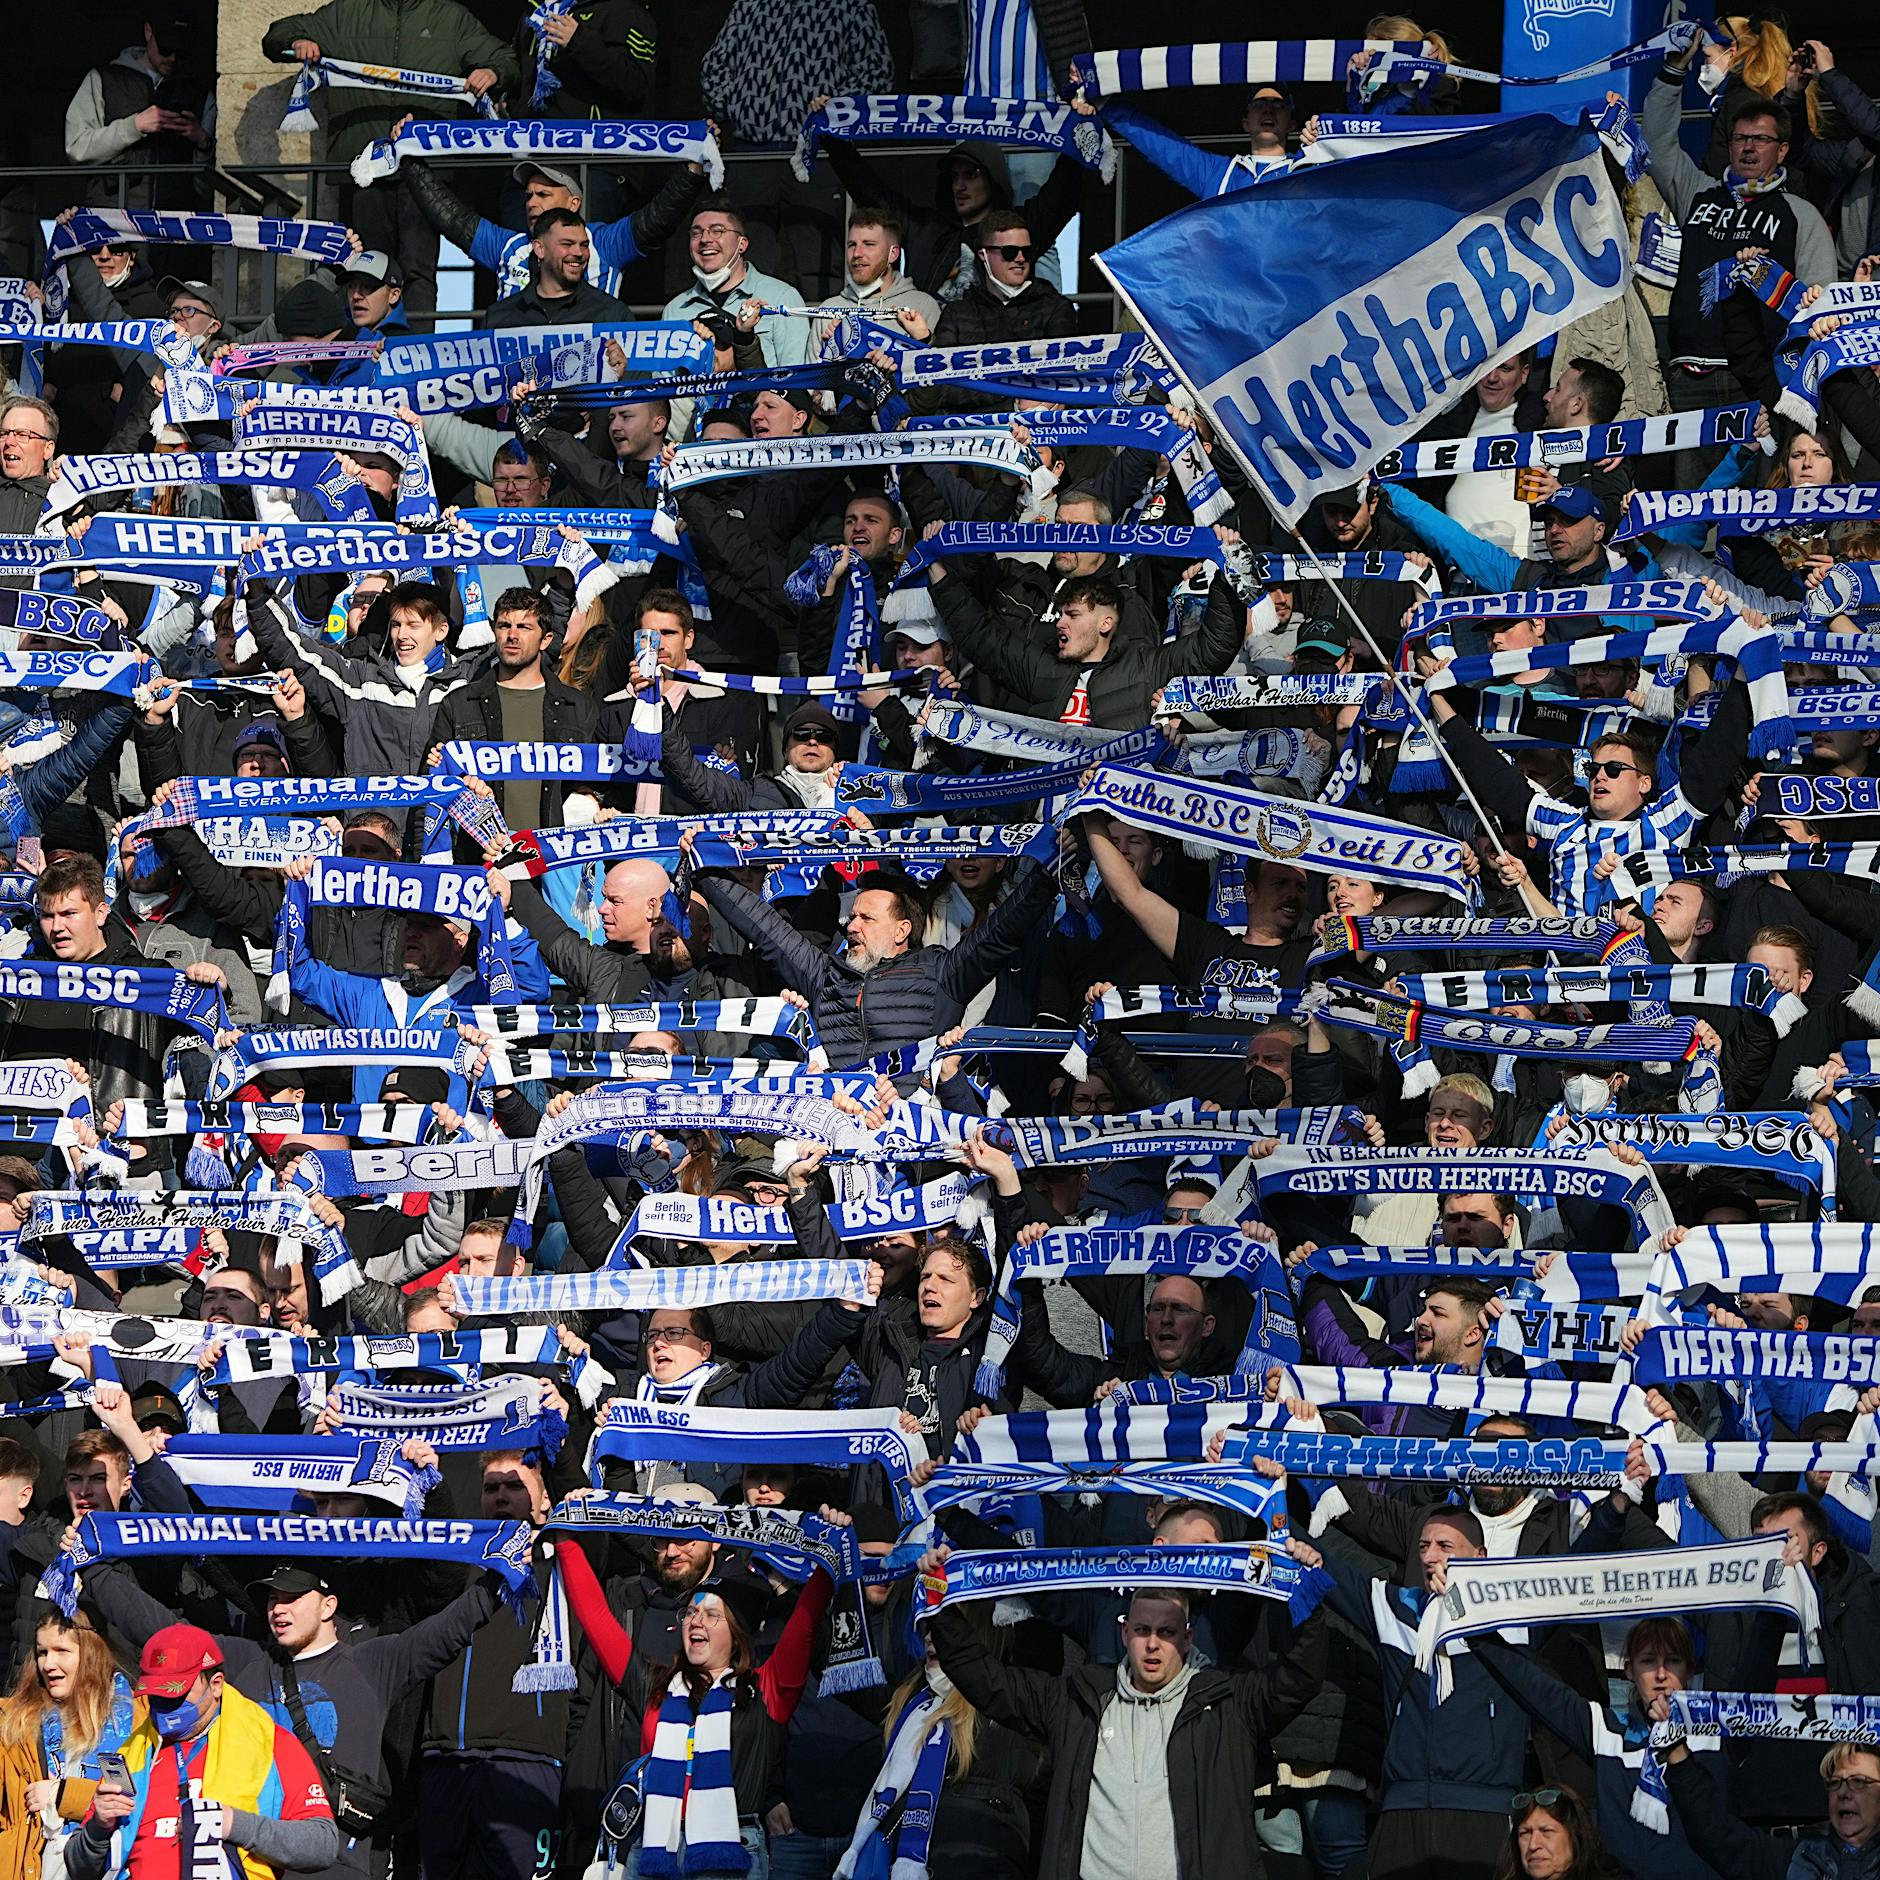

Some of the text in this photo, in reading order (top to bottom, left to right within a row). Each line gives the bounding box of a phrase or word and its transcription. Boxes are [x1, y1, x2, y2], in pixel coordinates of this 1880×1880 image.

[1625, 52, 1651, 65] Club
[400, 71, 453, 87] BERLIN
[825, 94, 1072, 135] BERLIN
[1342, 119, 1382, 134] 1892
[415, 120, 690, 152] Hertha BSC
[854, 121, 1065, 148] ARE THE CHAMPIONS
[1688, 202, 1782, 241] BERLIN
[1707, 227, 1752, 241] SEIT 1892
[1829, 287, 1854, 306] IN
[380, 328, 706, 376] ICH BIN WEISS
[1213, 173, 1622, 508] Hertha BSC
[914, 338, 1105, 375] BERLIN
[416, 367, 503, 412] BSC
[245, 410, 362, 437] HERTHA
[1137, 411, 1171, 437] 92
[244, 437, 368, 450] Olympiastadion
[62, 450, 300, 493] Hertha BSC
[673, 437, 1027, 480] ERTHANER AUS BERLIN
[1638, 484, 1874, 526] Hertha BSC
[939, 521, 1196, 547] HERTHA BSC
[264, 531, 516, 572] Hertha BSC
[1607, 580, 1711, 616] BSC
[17, 592, 111, 643] BSC
[29, 650, 114, 677] BSC
[1810, 650, 1870, 664] BERLIN
[1264, 687, 1319, 707] Hertha
[1796, 695, 1864, 714] BSC
[449, 741, 583, 776] Hertha
[197, 777, 358, 801] Hertha
[239, 792, 421, 808] EVERY DAY FAIR PLAY
[1085, 767, 1250, 835] Hertha BSC
[1778, 775, 1880, 816] BSC
[731, 811, 770, 820] DAMALS
[771, 810, 796, 819] MICH
[797, 810, 812, 818] DU
[814, 810, 840, 819] DASS
[546, 825, 661, 859] PAPA
[782, 844, 978, 856] DER VEREIN DEM ICH DIE TREUE SCHWÖRE
[1317, 835, 1387, 862] seit
[244, 850, 283, 862] EINEN
[309, 865, 423, 910] Hertha
[57, 964, 142, 1004] BSC
[166, 971, 188, 1017] SAISON
[252, 1028, 442, 1054] OLYMPIASTADION
[1566, 1112, 1692, 1154] Hertha
[1111, 1139, 1238, 1155] HAUPTSTADT
[1330, 1146, 1422, 1161] BERLIN
[1511, 1147, 1589, 1162] SPREE
[1288, 1167, 1607, 1198] GIBT'S NUR HERTHA BSC
[61, 1216, 92, 1231] nur
[170, 1207, 232, 1230] Hertha
[233, 1216, 267, 1232] nur
[644, 1211, 693, 1223] seit 1892
[655, 1201, 686, 1213] Berlin
[706, 1188, 919, 1235] Hert BSC
[72, 1227, 188, 1253] PAPA
[1015, 1228, 1268, 1273] HERTHA BSC
[99, 1252, 166, 1263] MITGENOMMEN
[1660, 1329, 1814, 1379] HERTHA
[606, 1404, 691, 1427] ERTHA BSC
[1242, 1429, 1604, 1479] HERTHA BSC
[253, 1461, 343, 1482] HERTHA BSC
[1463, 1463, 1622, 1489] Traditionsverein
[116, 1517, 474, 1546] EINMAL HERTHANER
[714, 1526, 772, 1545] BERLIN
[840, 1530, 853, 1577] VEREIN
[959, 1550, 1111, 1589] Karlsruhe
[1115, 1550, 1141, 1573] &
[1143, 1548, 1235, 1578] Berlin
[1466, 1558, 1760, 1606] OSTKURVE HERTHA BSC
[1608, 1598, 1618, 1606] die
[829, 1648, 866, 1663] BERLIN
[1691, 1718, 1879, 1747] nur Hertha
